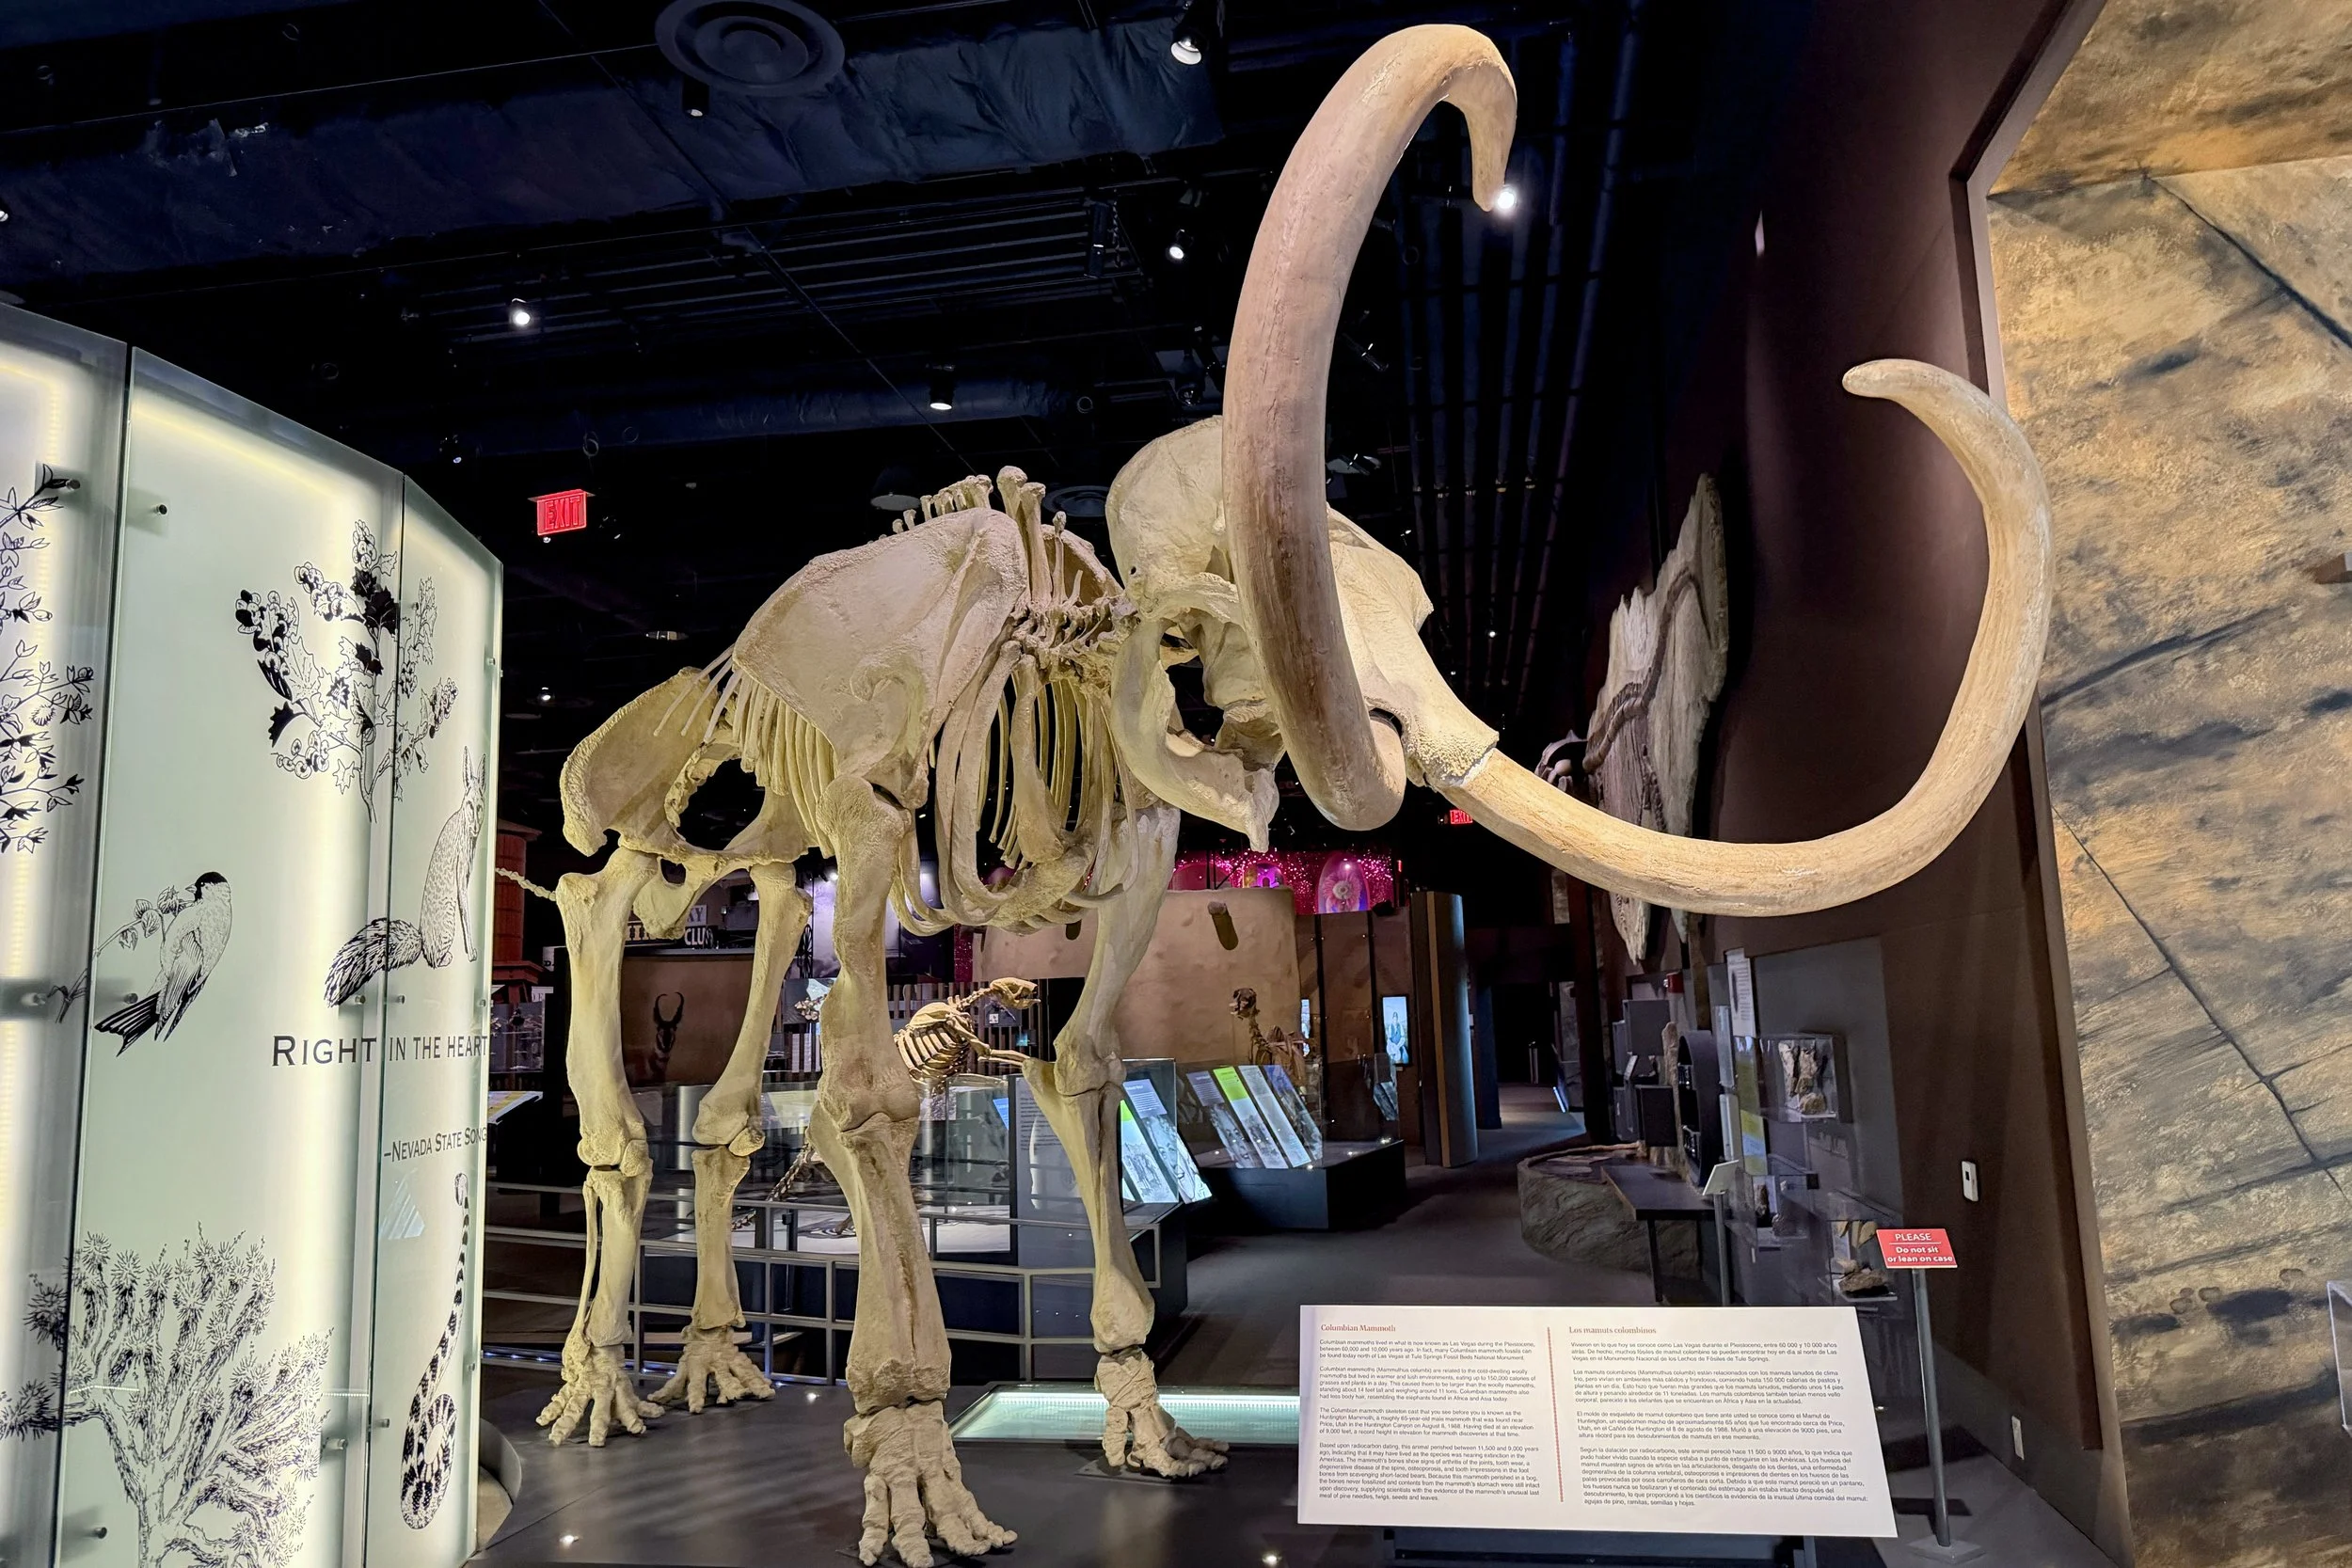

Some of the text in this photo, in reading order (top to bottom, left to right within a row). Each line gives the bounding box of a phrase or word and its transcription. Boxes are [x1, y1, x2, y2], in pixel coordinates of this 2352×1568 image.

[545, 496, 580, 530] EXIT
[1454, 810, 1470, 822] EXI
[272, 1036, 488, 1066] RIGHT IN THE HEART
[435, 1132, 461, 1152] STATE
[464, 1127, 487, 1145] SONG
